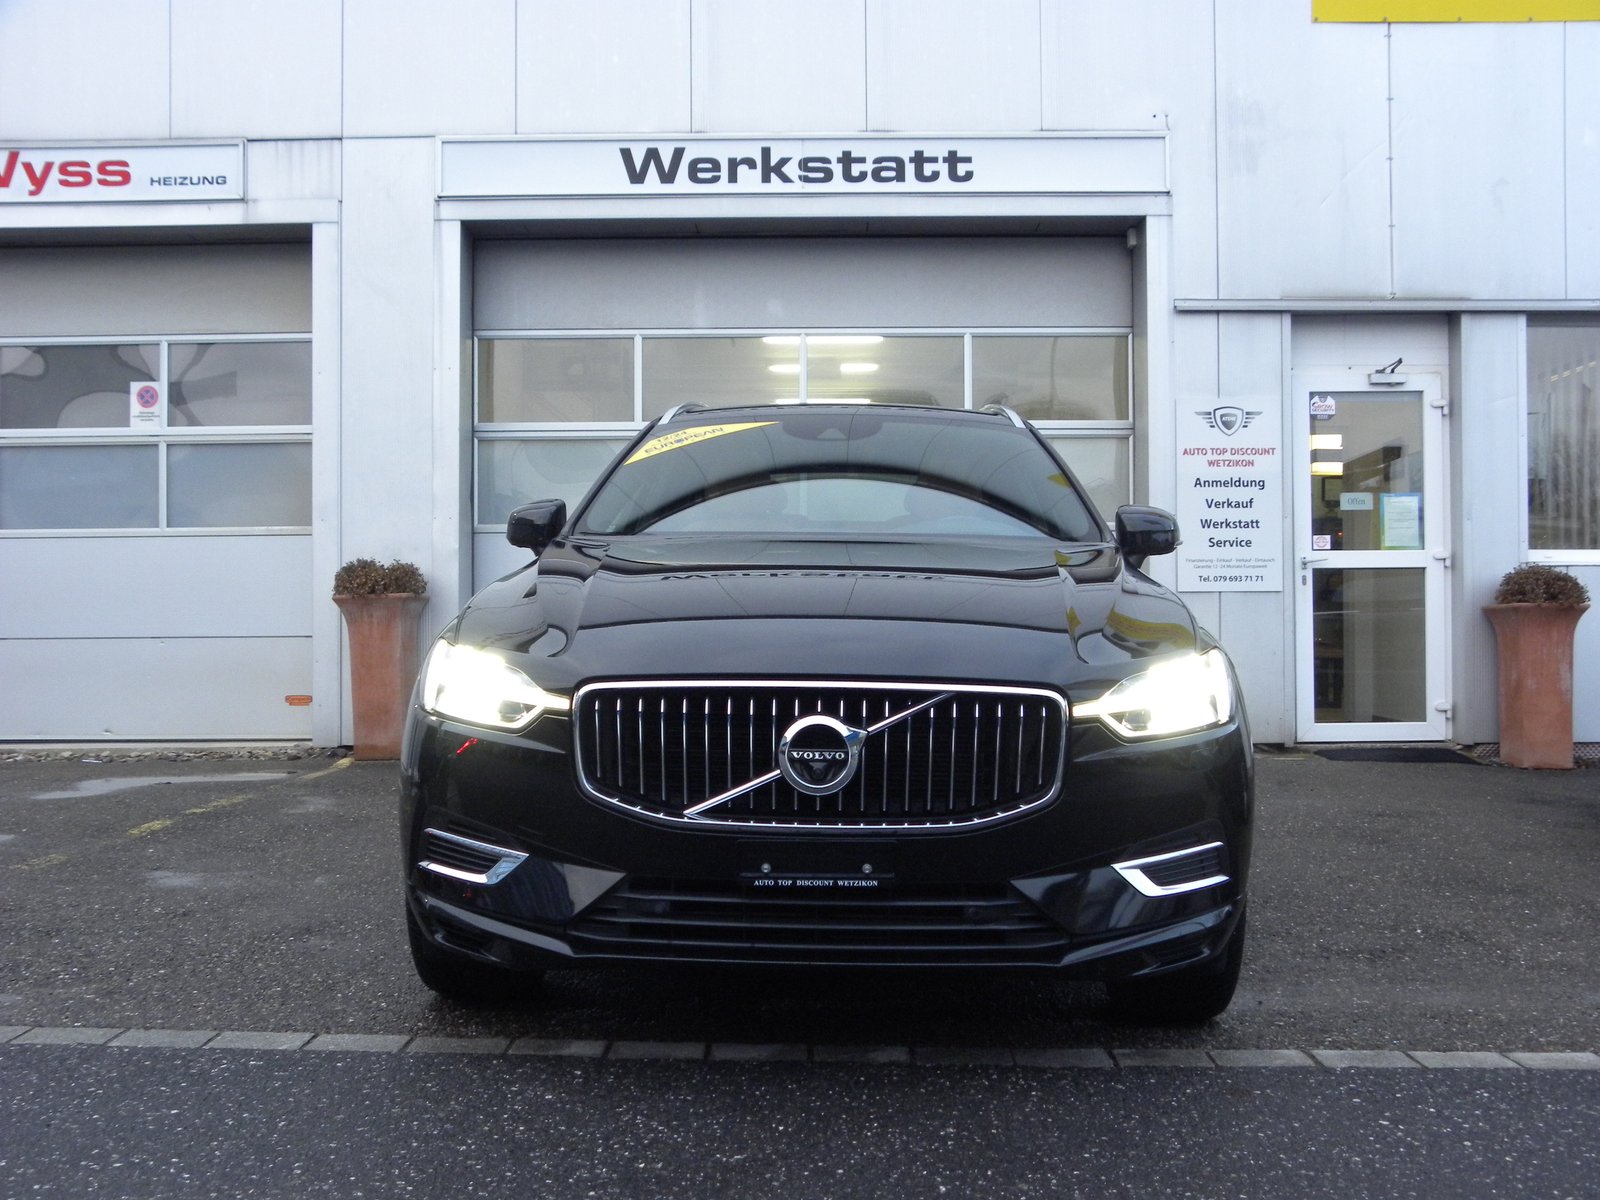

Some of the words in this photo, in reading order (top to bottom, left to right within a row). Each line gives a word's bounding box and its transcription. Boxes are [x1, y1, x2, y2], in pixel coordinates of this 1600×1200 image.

[619, 146, 974, 184] Werkstatt
[150, 176, 227, 186] HEIZUNG
[1207, 459, 1254, 467] WETZIKON
[1194, 477, 1265, 490] Anmeldung
[1205, 498, 1254, 508] Verkauf
[1200, 518, 1260, 529] Werkstatt
[1208, 537, 1252, 547] Service
[791, 751, 845, 760] VOLVO
